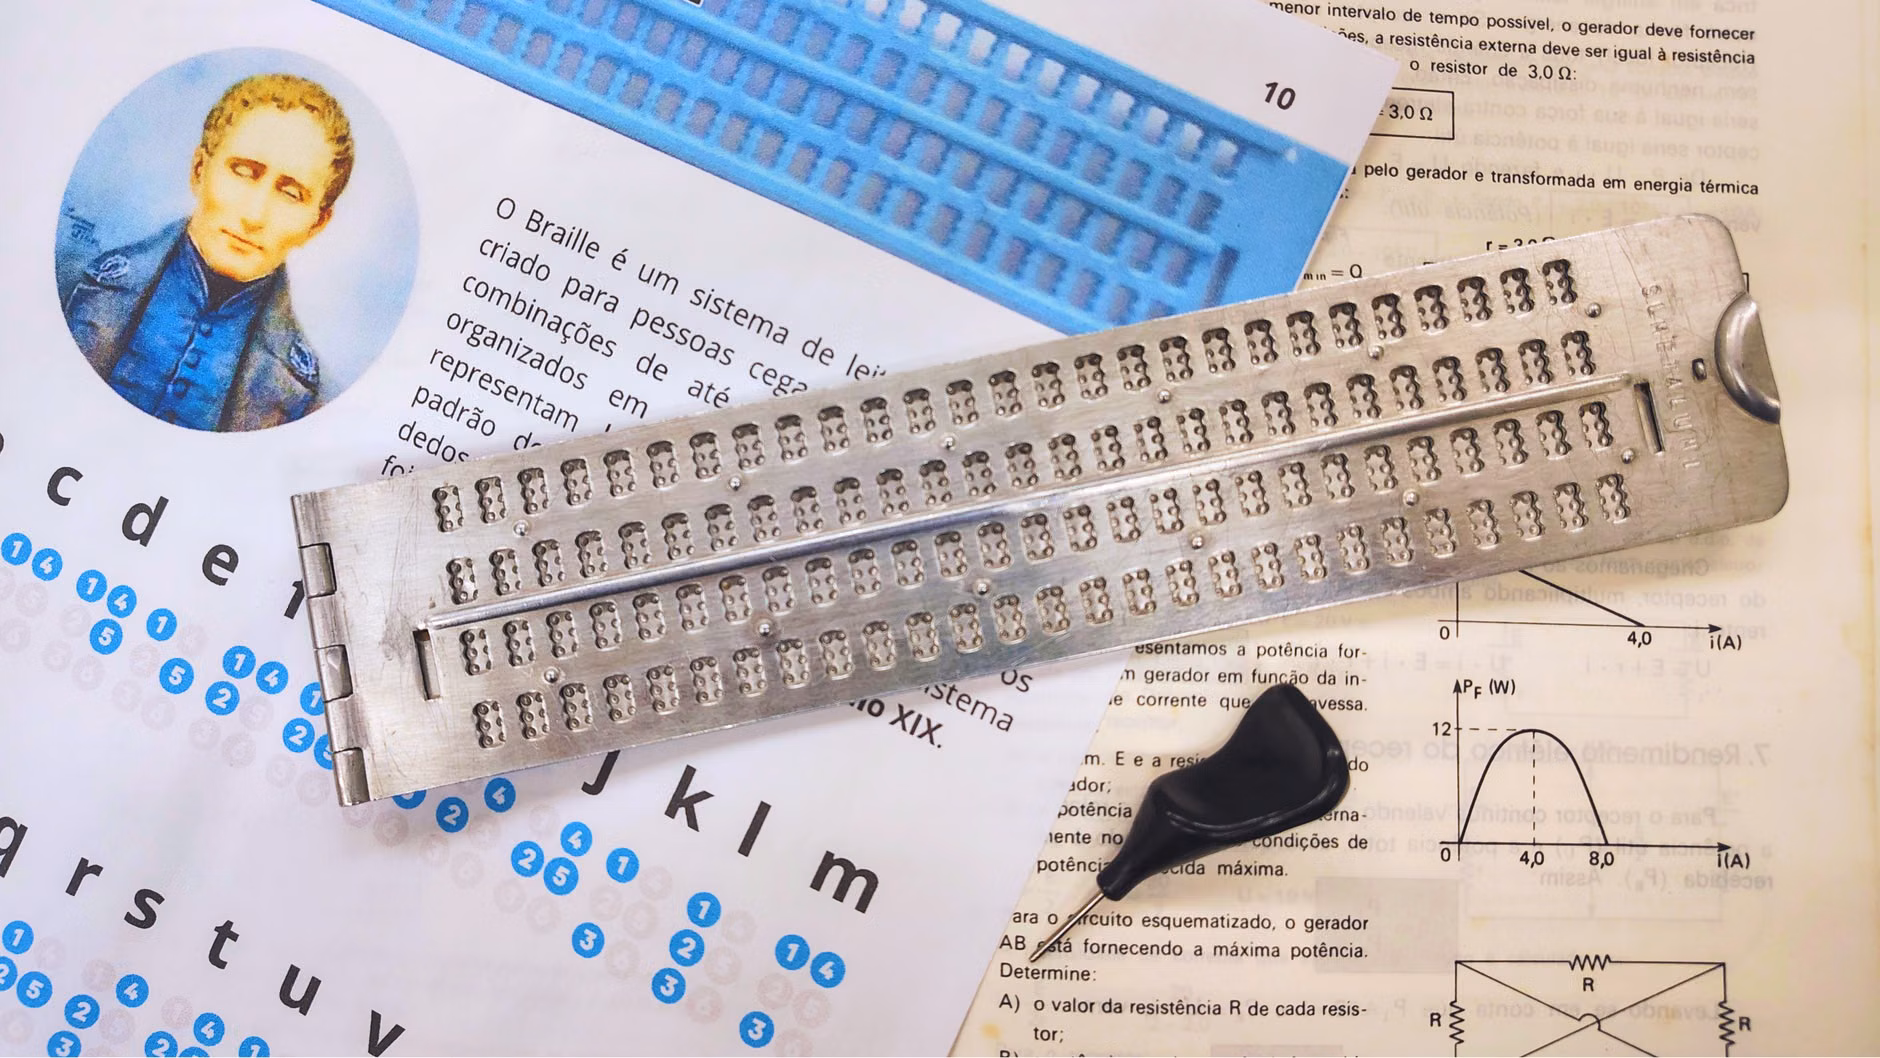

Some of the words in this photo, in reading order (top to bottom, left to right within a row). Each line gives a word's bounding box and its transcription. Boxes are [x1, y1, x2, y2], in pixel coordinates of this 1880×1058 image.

[1269, 1, 1320, 16] menor
[1327, 2, 1396, 22] intervalo
[1403, 8, 1422, 22] de
[1430, 11, 1479, 29] tempo
[1487, 16, 1554, 32] possível,
[1562, 21, 1572, 32] o
[1578, 20, 1640, 36] gerador
[1646, 22, 1683, 38] deve
[1690, 24, 1756, 41] fornecer
[1375, 33, 1384, 45] a
[1390, 32, 1473, 51] resistência
[1479, 40, 1537, 55] externa
[1542, 41, 1580, 57] deve
[1585, 46, 1608, 58] ser
[1614, 45, 1652, 62] igual
[1657, 47, 1667, 62] à
[1672, 47, 1756, 65] resistência
[1410, 60, 1420, 71] o
[1431, 58, 1488, 75] resistor
[1498, 63, 1518, 77] de
[1264, 81, 1296, 111] 10
[1389, 104, 1415, 121] 3,0
[1364, 163, 1399, 178] pelo
[1406, 166, 1468, 182] gerador
[1475, 170, 1484, 182] e
[1491, 170, 1595, 189] transformada
[1603, 178, 1626, 190] em
[1634, 177, 1693, 195] energia
[1700, 180, 1759, 195] térmica
[496, 197, 516, 220] O
[525, 208, 601, 260] Braille
[611, 248, 629, 271] é
[638, 263, 680, 296] um
[690, 288, 790, 345] sistema
[801, 336, 835, 367] de
[845, 353, 887, 382] lei
[479, 238, 551, 282] criado
[560, 275, 620, 314] para
[628, 307, 736, 366] pessoas
[462, 275, 617, 359] combinações
[635, 353, 669, 383] de
[687, 379, 731, 409] até
[446, 312, 589, 390] organizados
[608, 388, 649, 419] em
[429, 348, 579, 433] representam
[411, 385, 496, 438] padrão
[47, 466, 84, 507] c
[121, 495, 170, 548] d
[202, 543, 240, 586] e
[1237, 645, 1246, 657] a
[1256, 643, 1328, 659] potência
[1338, 643, 1368, 659] for-
[1627, 630, 1653, 648] 4,0
[1709, 633, 1743, 652] i(A)
[1144, 667, 1210, 684] gerador
[1217, 671, 1243, 684] em
[1251, 669, 1309, 685] função
[1317, 669, 1337, 686] da
[1345, 670, 1368, 686] in-
[1488, 679, 1516, 697] (W)
[1136, 693, 1207, 708] corrente
[1219, 695, 1251, 712] que
[888, 703, 944, 749] XIX.
[1432, 721, 1452, 737] 12
[1116, 751, 1126, 766] E
[1133, 755, 1144, 767] e
[1151, 756, 1161, 768] a
[1170, 753, 1207, 768] resi
[1057, 801, 1133, 819] potência
[664, 765, 715, 833] k
[737, 801, 772, 858] l
[810, 850, 880, 914] m
[1101, 833, 1124, 845] no
[1252, 833, 1339, 852] condições
[1347, 834, 1368, 850] de
[1217, 860, 1288, 877] máxima.
[1519, 850, 1546, 868] 4,0
[1588, 851, 1615, 868] 8,0
[1716, 851, 1751, 870] i(A)
[1047, 913, 1059, 925] o
[1141, 913, 1276, 932] esquematizado,
[1285, 917, 1296, 930] o
[1304, 915, 1369, 933] gerador
[65, 856, 104, 897] r
[123, 888, 166, 930] s
[207, 919, 240, 970] t
[278, 963, 322, 1017] u
[367, 1009, 406, 1058] v
[999, 934, 1026, 951] AB
[1084, 938, 1183, 957] fornecendo
[1193, 944, 1203, 957] a
[1213, 941, 1281, 958] máxima
[1290, 942, 1368, 961] potência.
[1000, 962, 1097, 982] Determine:
[1583, 977, 1595, 993] R
[998, 993, 1021, 1014] A)
[1033, 999, 1045, 1011] o
[1051, 997, 1096, 1014] valor
[1101, 998, 1123, 1014] da
[1129, 999, 1222, 1016] resistência
[1229, 1000, 1241, 1015] R
[1247, 1001, 1269, 1016] de
[1275, 1001, 1316, 1016] cada
[1322, 1000, 1367, 1016] resis-
[1430, 1013, 1441, 1028] R
[1739, 1017, 1752, 1031] R
[1033, 1026, 1065, 1043] tor;
